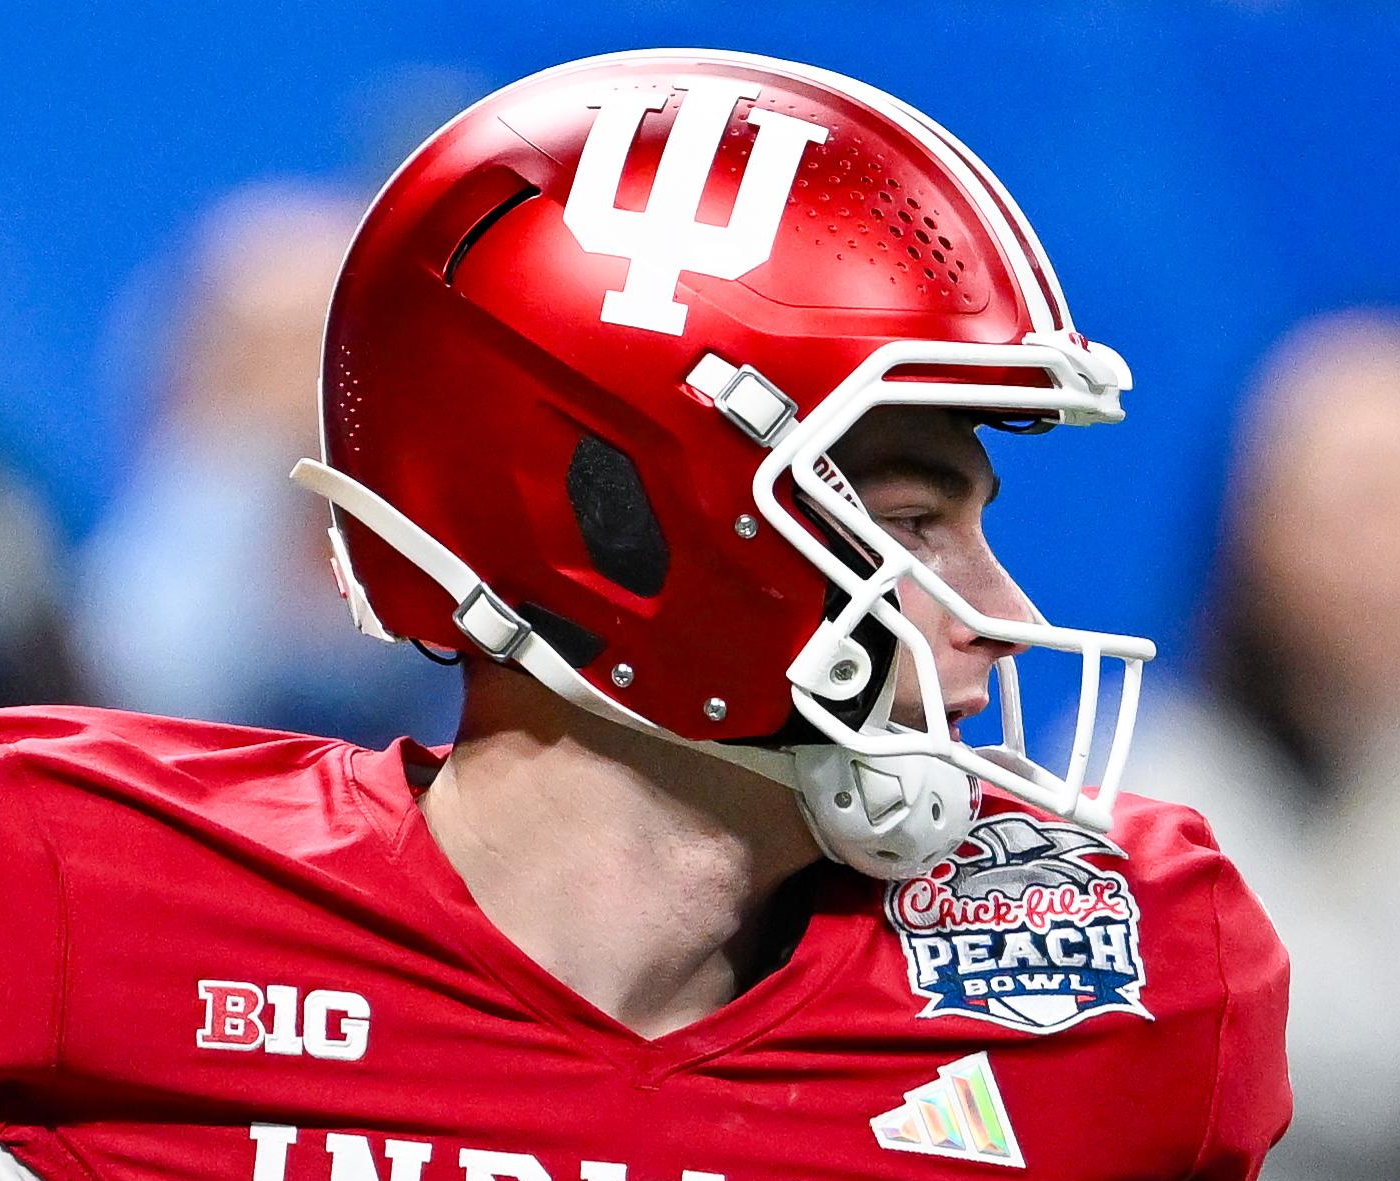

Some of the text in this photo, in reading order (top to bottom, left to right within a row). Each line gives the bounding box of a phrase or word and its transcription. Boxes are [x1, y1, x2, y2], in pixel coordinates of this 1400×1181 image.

[898, 864, 1123, 930] Chick-fil-A
[908, 924, 1136, 988] PEACH
[963, 973, 1095, 996] BOWL
